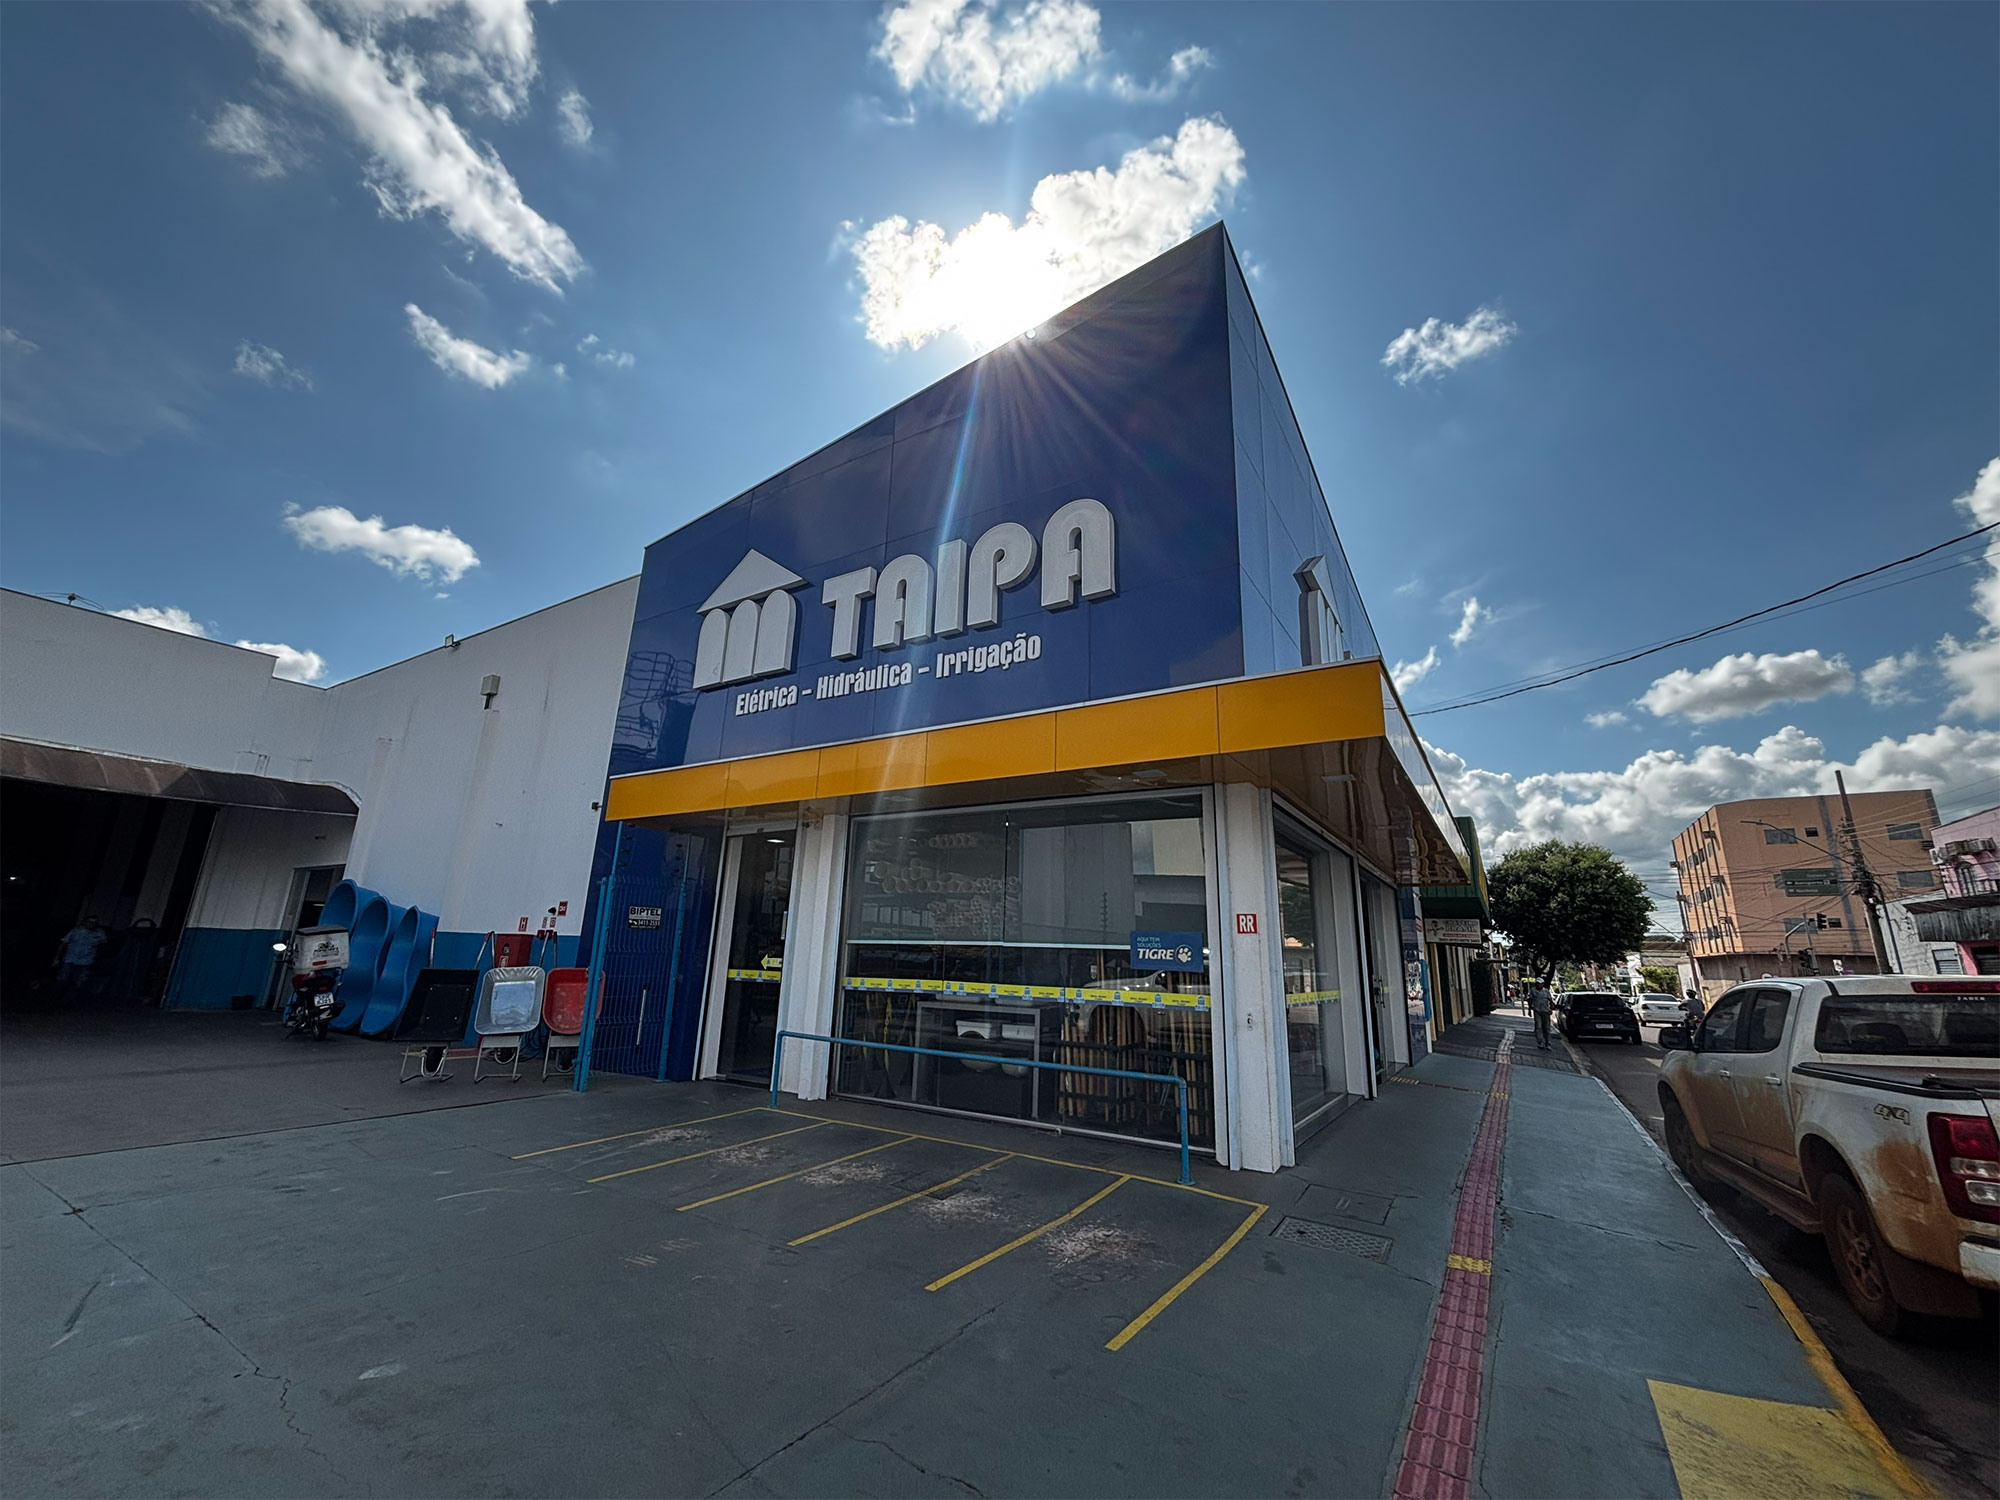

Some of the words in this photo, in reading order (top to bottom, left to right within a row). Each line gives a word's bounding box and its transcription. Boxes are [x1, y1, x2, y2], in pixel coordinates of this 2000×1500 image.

[822, 498, 1115, 659] TAIPA
[735, 685, 798, 716] Elétrica
[816, 662, 912, 699] Hidráulica
[936, 632, 1041, 678] Irrigação
[630, 907, 661, 916] BIPTEL
[1239, 915, 1254, 932] RR
[1137, 949, 1174, 960] TIGRE
